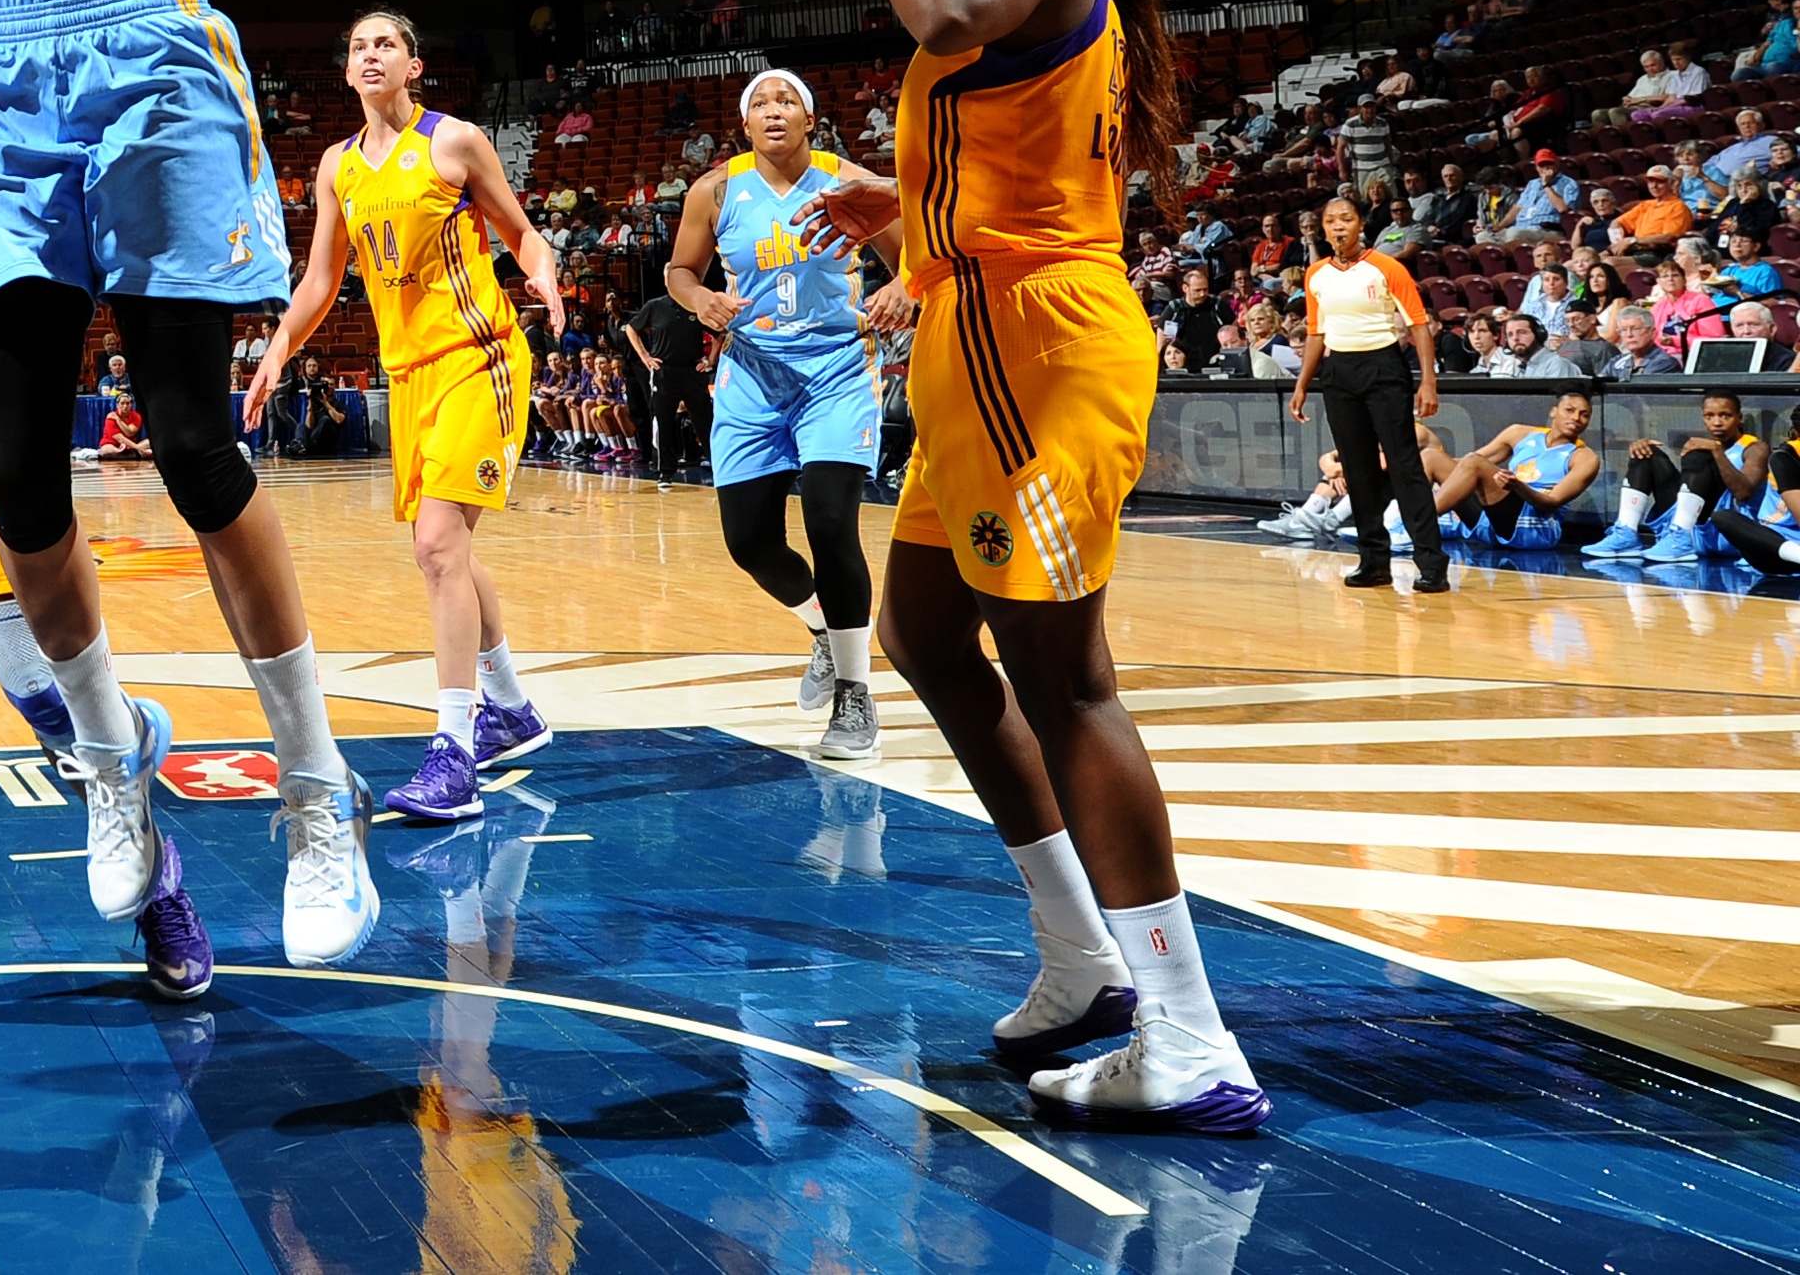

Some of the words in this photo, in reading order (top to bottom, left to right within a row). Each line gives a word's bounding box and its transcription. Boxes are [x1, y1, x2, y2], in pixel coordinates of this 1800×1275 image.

[354, 196, 418, 218] EquiTrust
[361, 219, 400, 272] 14
[776, 271, 797, 317] 9
